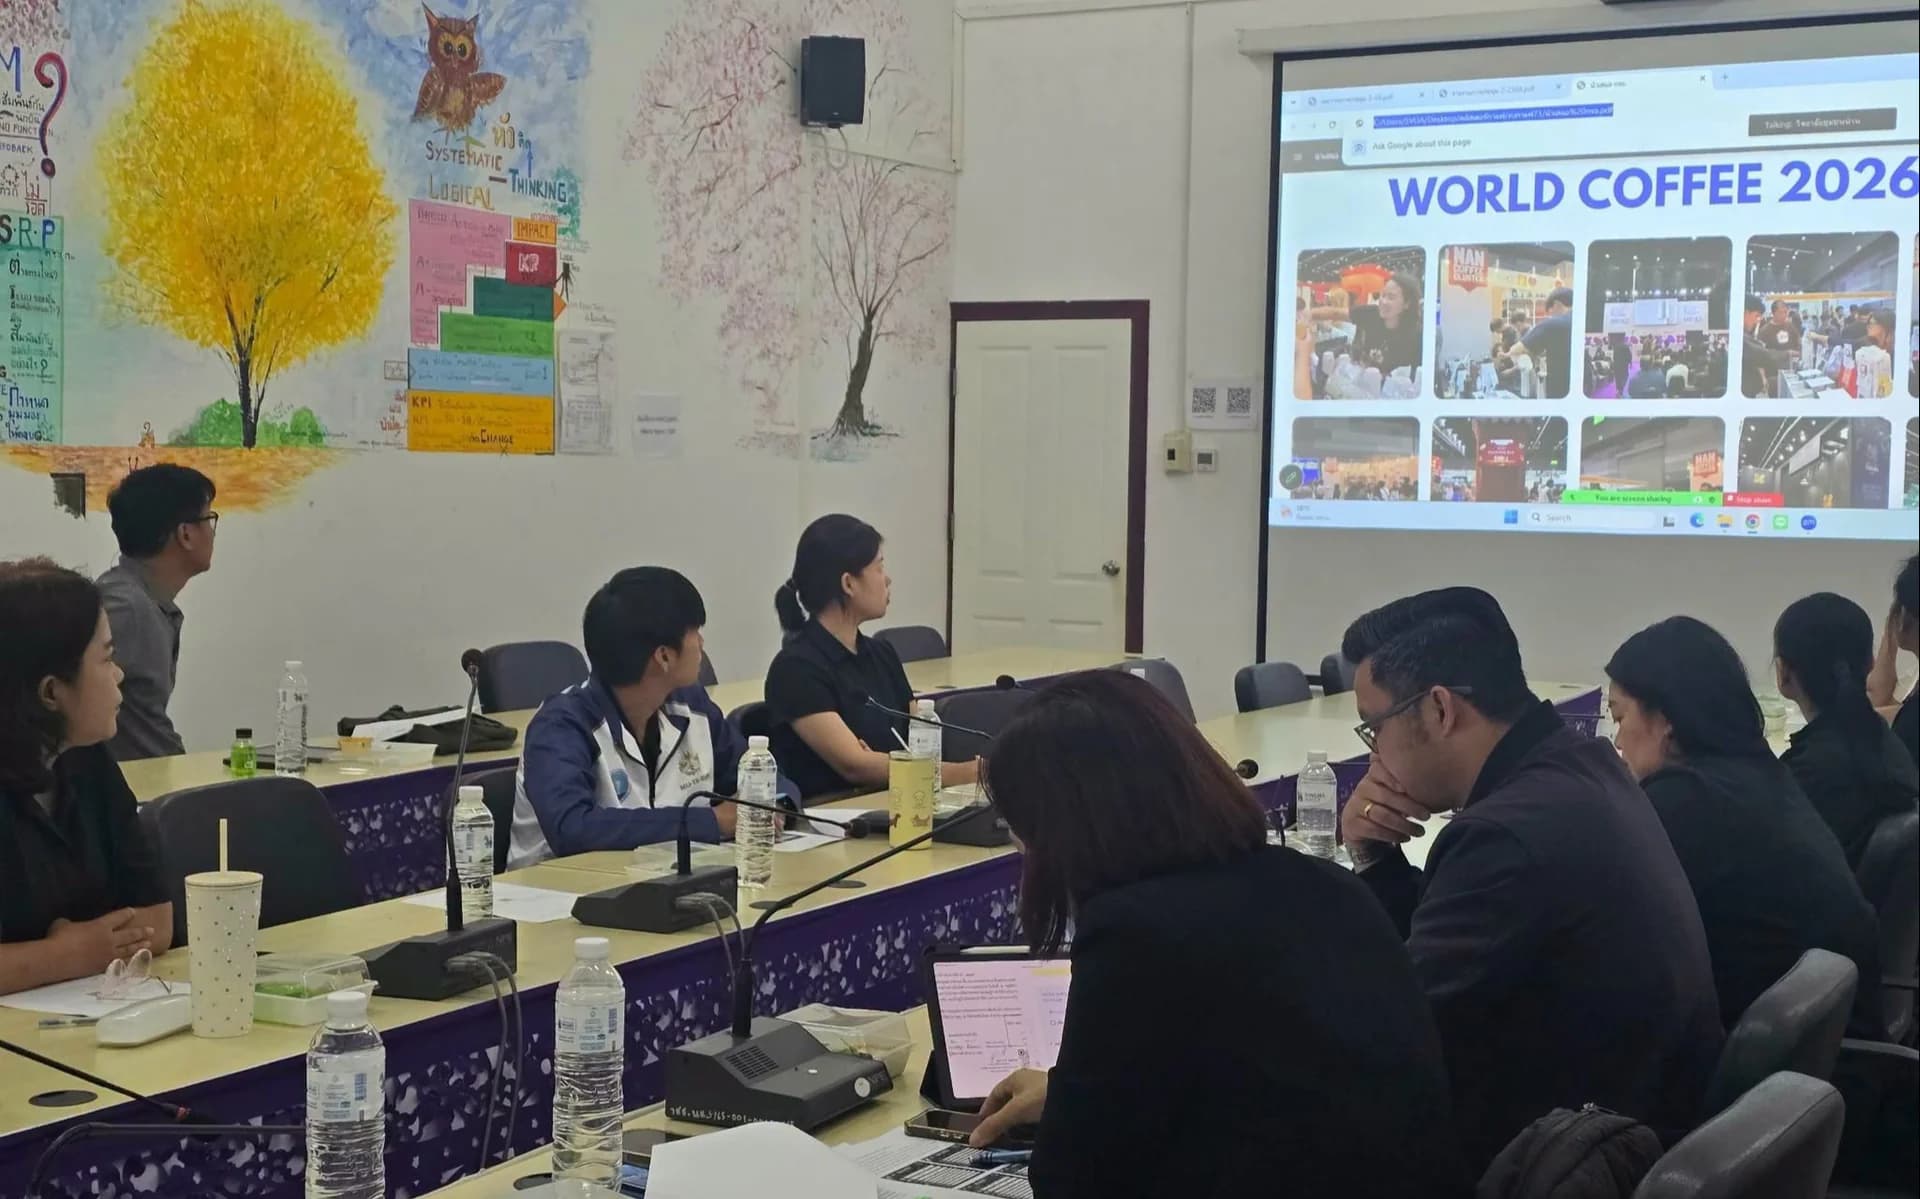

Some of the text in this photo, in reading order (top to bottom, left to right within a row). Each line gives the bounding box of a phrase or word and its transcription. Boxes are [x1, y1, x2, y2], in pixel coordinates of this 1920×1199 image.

[1387, 141, 1413, 151] Google
[1415, 139, 1436, 148] about
[1437, 138, 1451, 147] this
[1452, 138, 1472, 148] page
[425, 140, 503, 171] SYSTEMATIC
[429, 174, 495, 211] LOGICAL
[508, 168, 567, 204] THINKING
[1388, 155, 1919, 217] WORLD COFFEE 2026
[517, 222, 550, 239] IMPACT
[1453, 246, 1485, 267] NAN
[411, 396, 432, 408] KPI
[480, 429, 514, 445] CHANGE
[1595, 494, 1609, 502] You
[1646, 494, 1672, 504] sharing
[1546, 512, 1571, 522] Search
